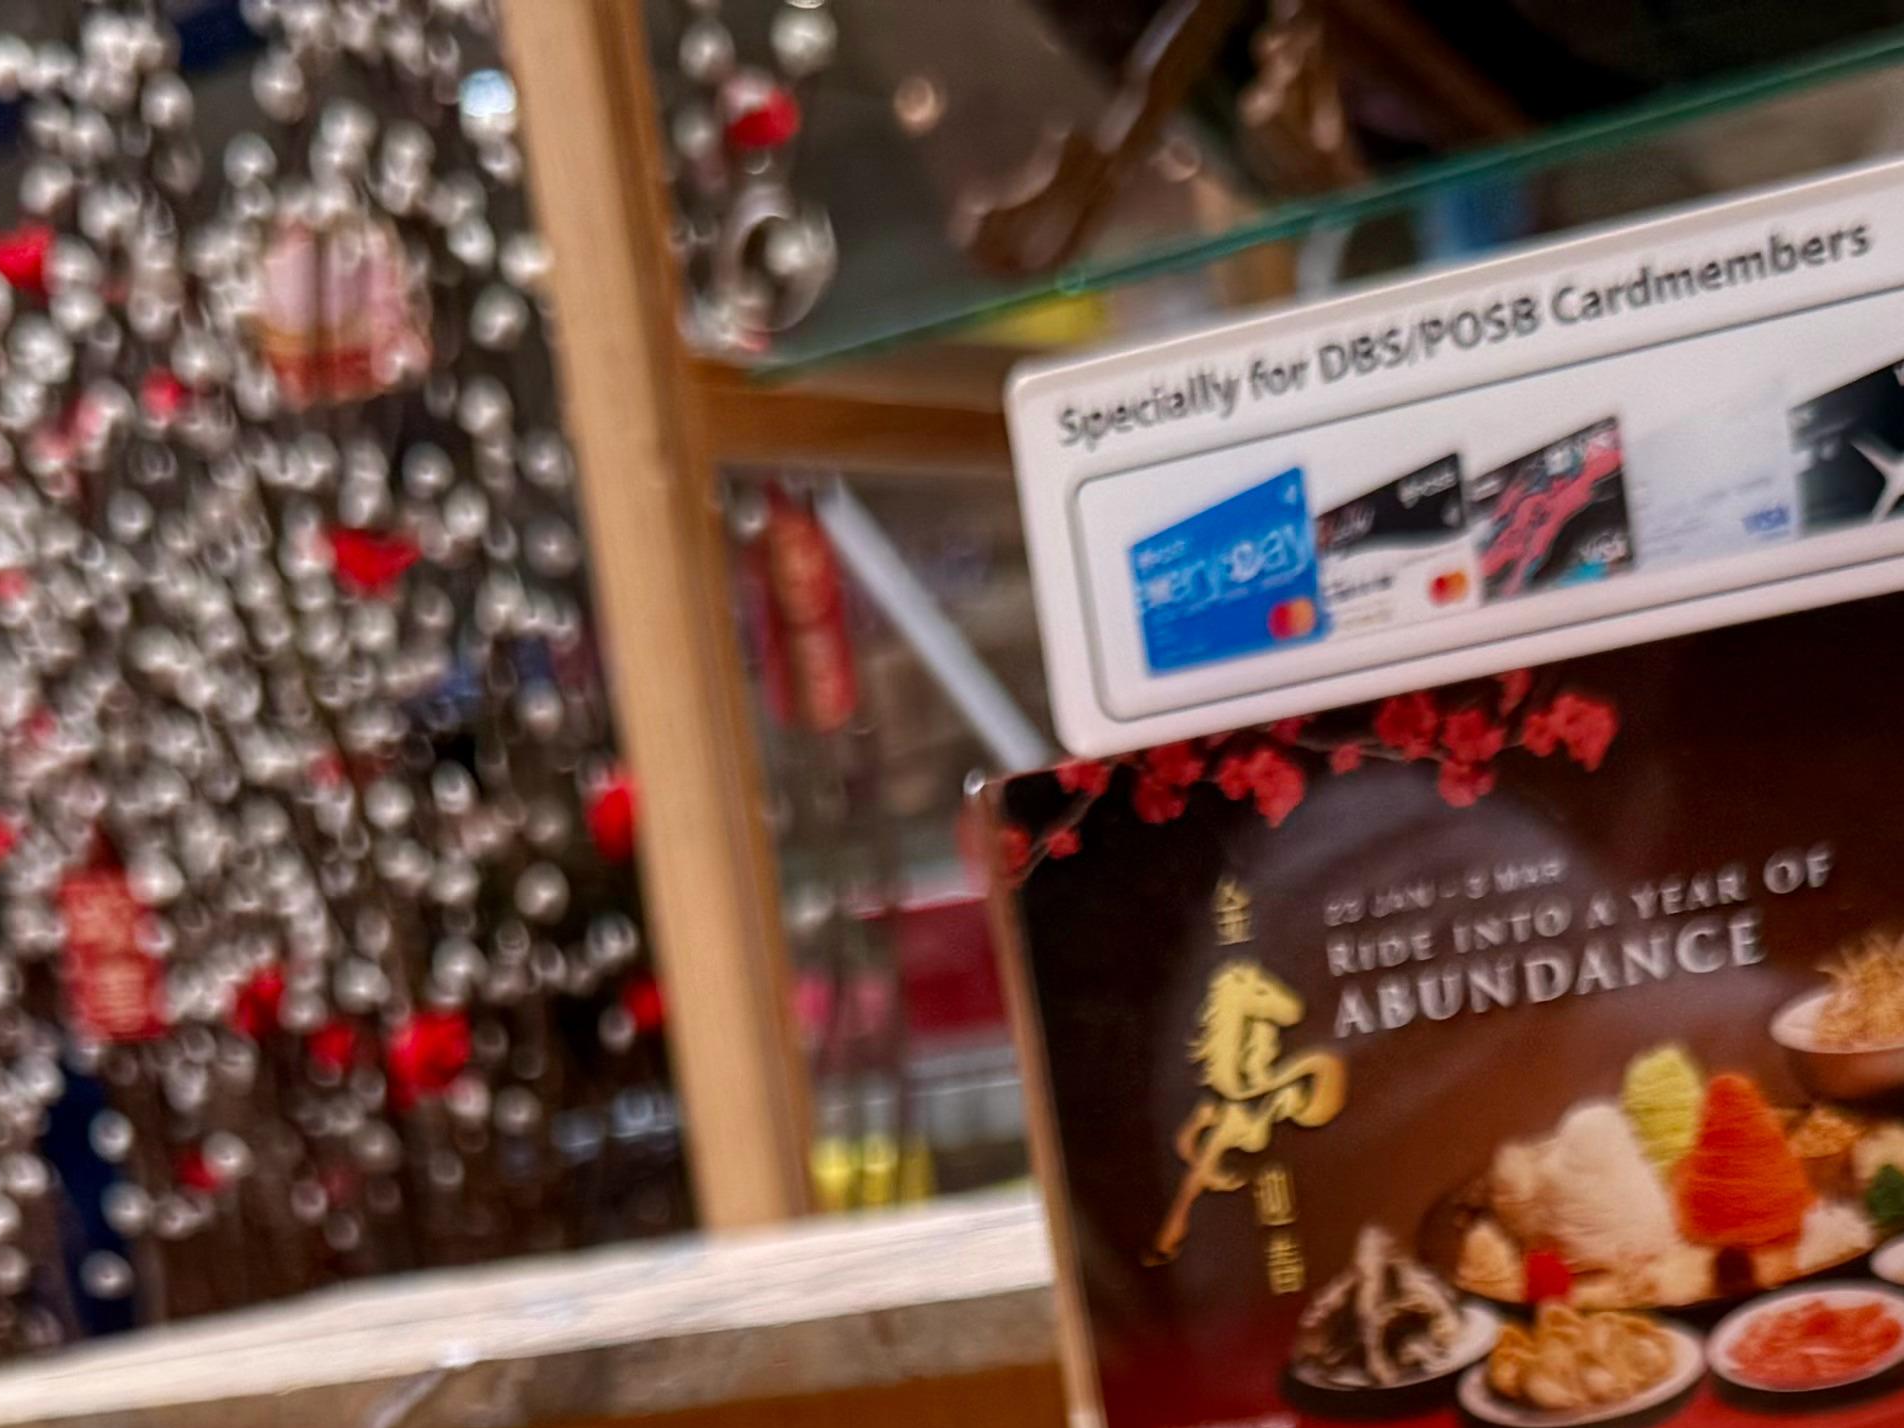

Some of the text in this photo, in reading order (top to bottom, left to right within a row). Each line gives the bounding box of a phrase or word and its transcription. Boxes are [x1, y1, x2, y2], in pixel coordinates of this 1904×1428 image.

[1058, 223, 1872, 449] Specially for DBS/POSB Cardmembers
[1326, 844, 1834, 976] RIDE INTO A YEAR OF
[1334, 906, 1767, 1038] ABUNDANCE
